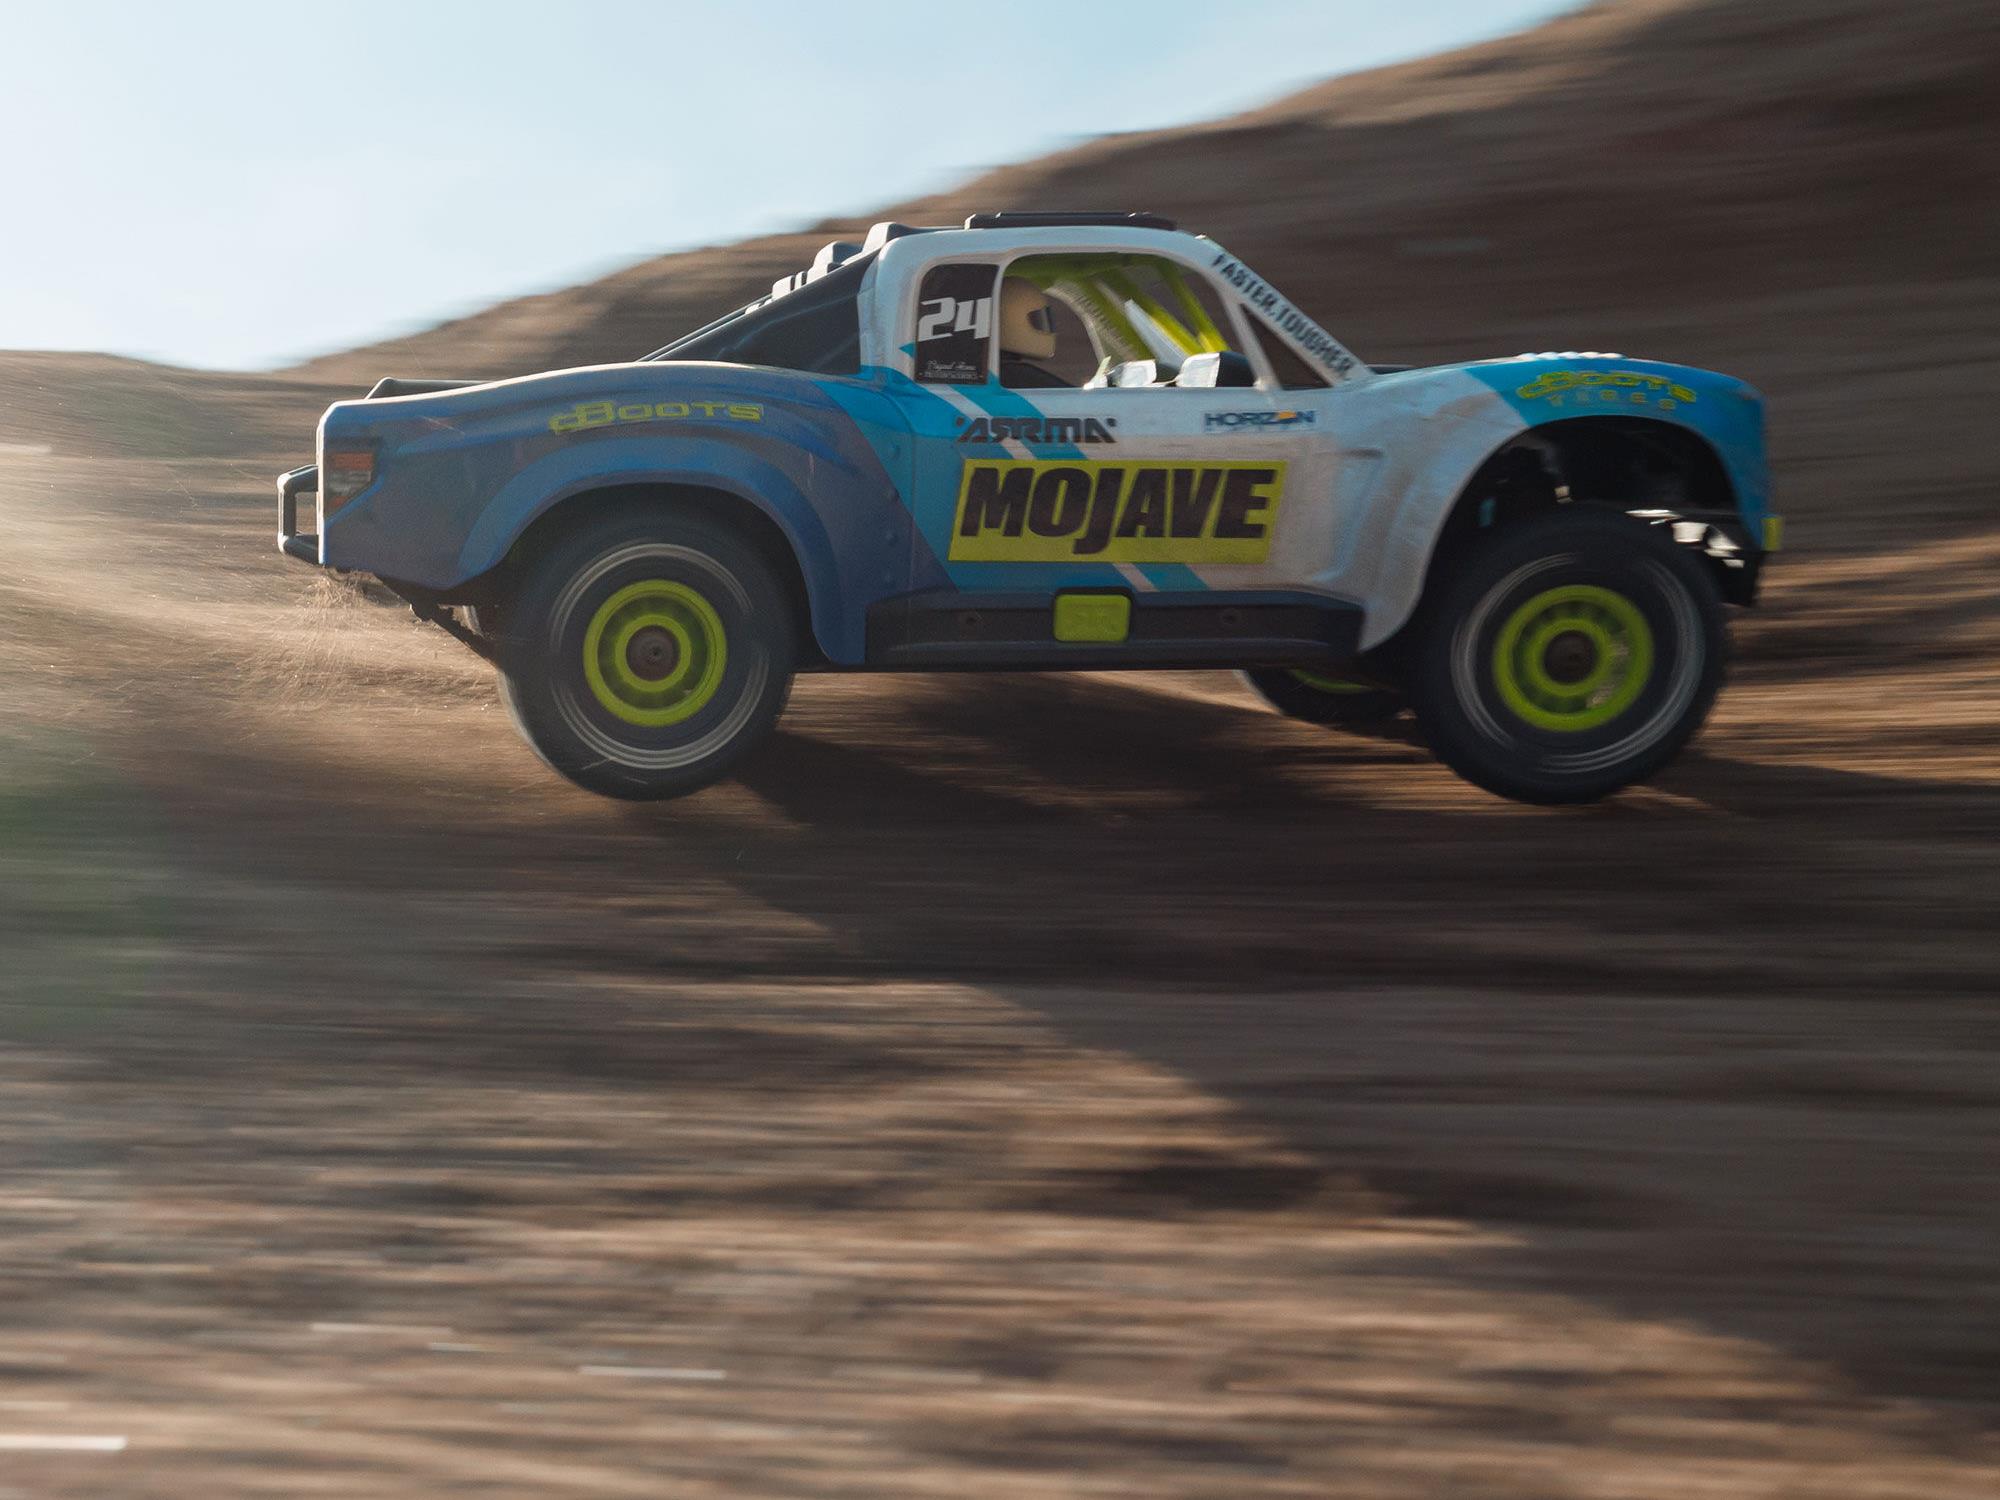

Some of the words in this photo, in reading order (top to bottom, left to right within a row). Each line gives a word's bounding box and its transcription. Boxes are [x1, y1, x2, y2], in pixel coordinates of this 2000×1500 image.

[918, 297, 992, 341] 24
[956, 417, 1117, 443] ARRMA
[960, 467, 1276, 555] MOJAVE
